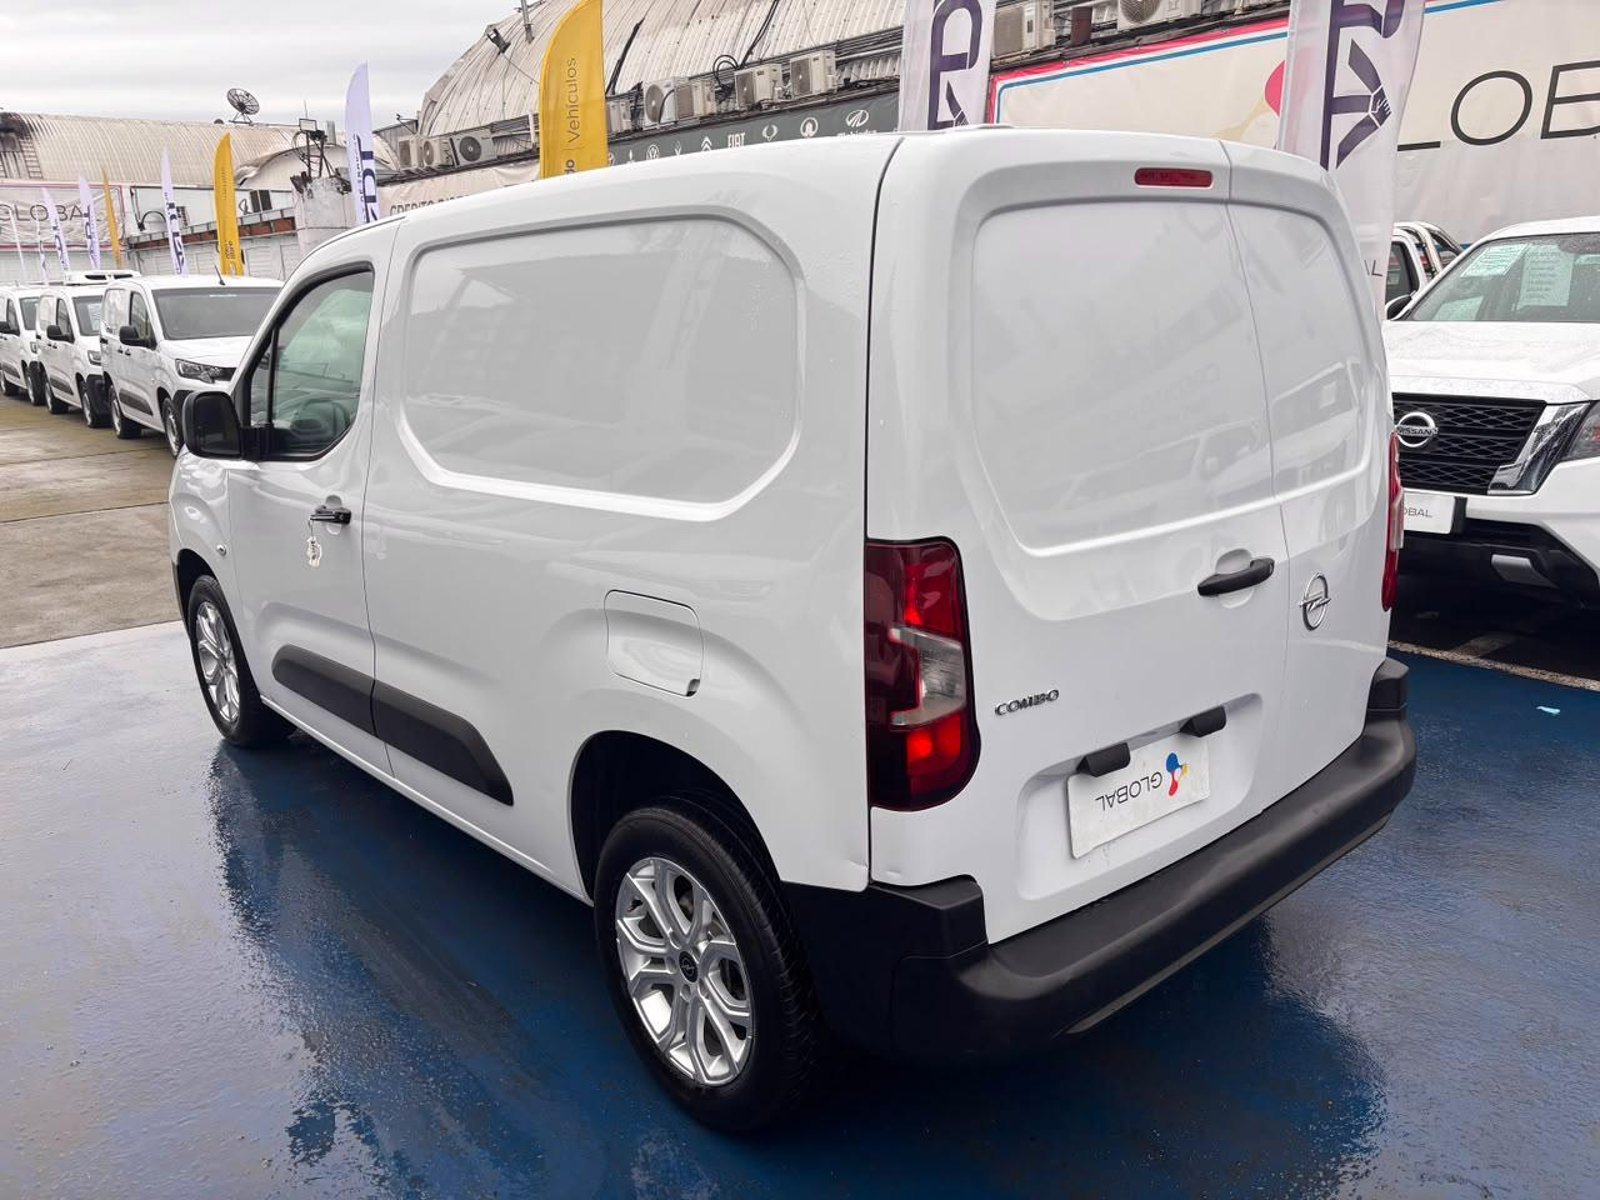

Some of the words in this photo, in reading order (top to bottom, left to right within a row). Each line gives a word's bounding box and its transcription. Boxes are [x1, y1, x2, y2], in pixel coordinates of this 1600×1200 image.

[728, 132, 746, 149] FIAT
[995, 689, 1059, 716] COMBO
[1095, 771, 1163, 811] GLOBAL
